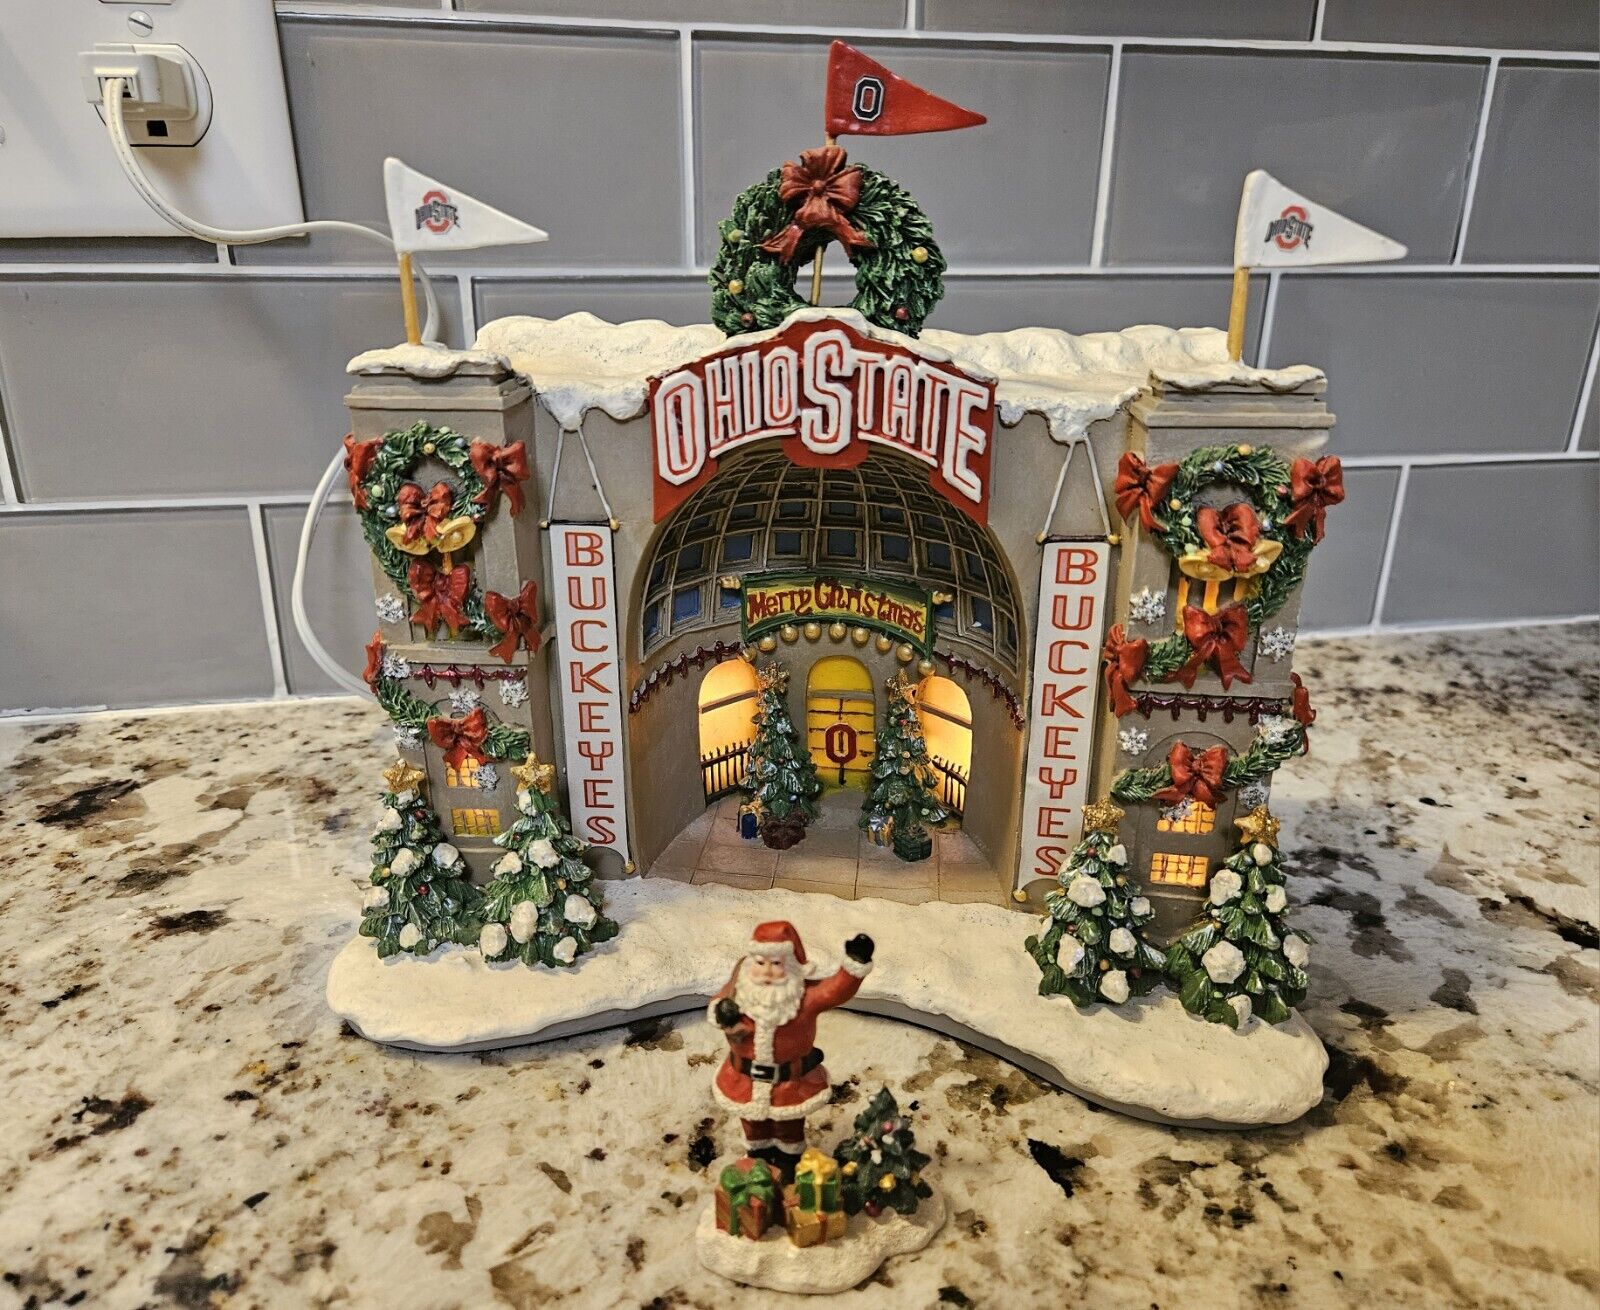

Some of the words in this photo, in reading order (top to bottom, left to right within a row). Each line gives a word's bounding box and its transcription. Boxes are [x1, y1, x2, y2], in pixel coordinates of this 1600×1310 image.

[852, 76, 884, 121] O
[654, 346, 798, 485] OHIO
[801, 329, 989, 503] STATE
[564, 531, 616, 845] BUCKEYES
[747, 590, 812, 624] Merry
[814, 576, 924, 634] Christmas
[1034, 548, 1099, 876] BUCKEYES
